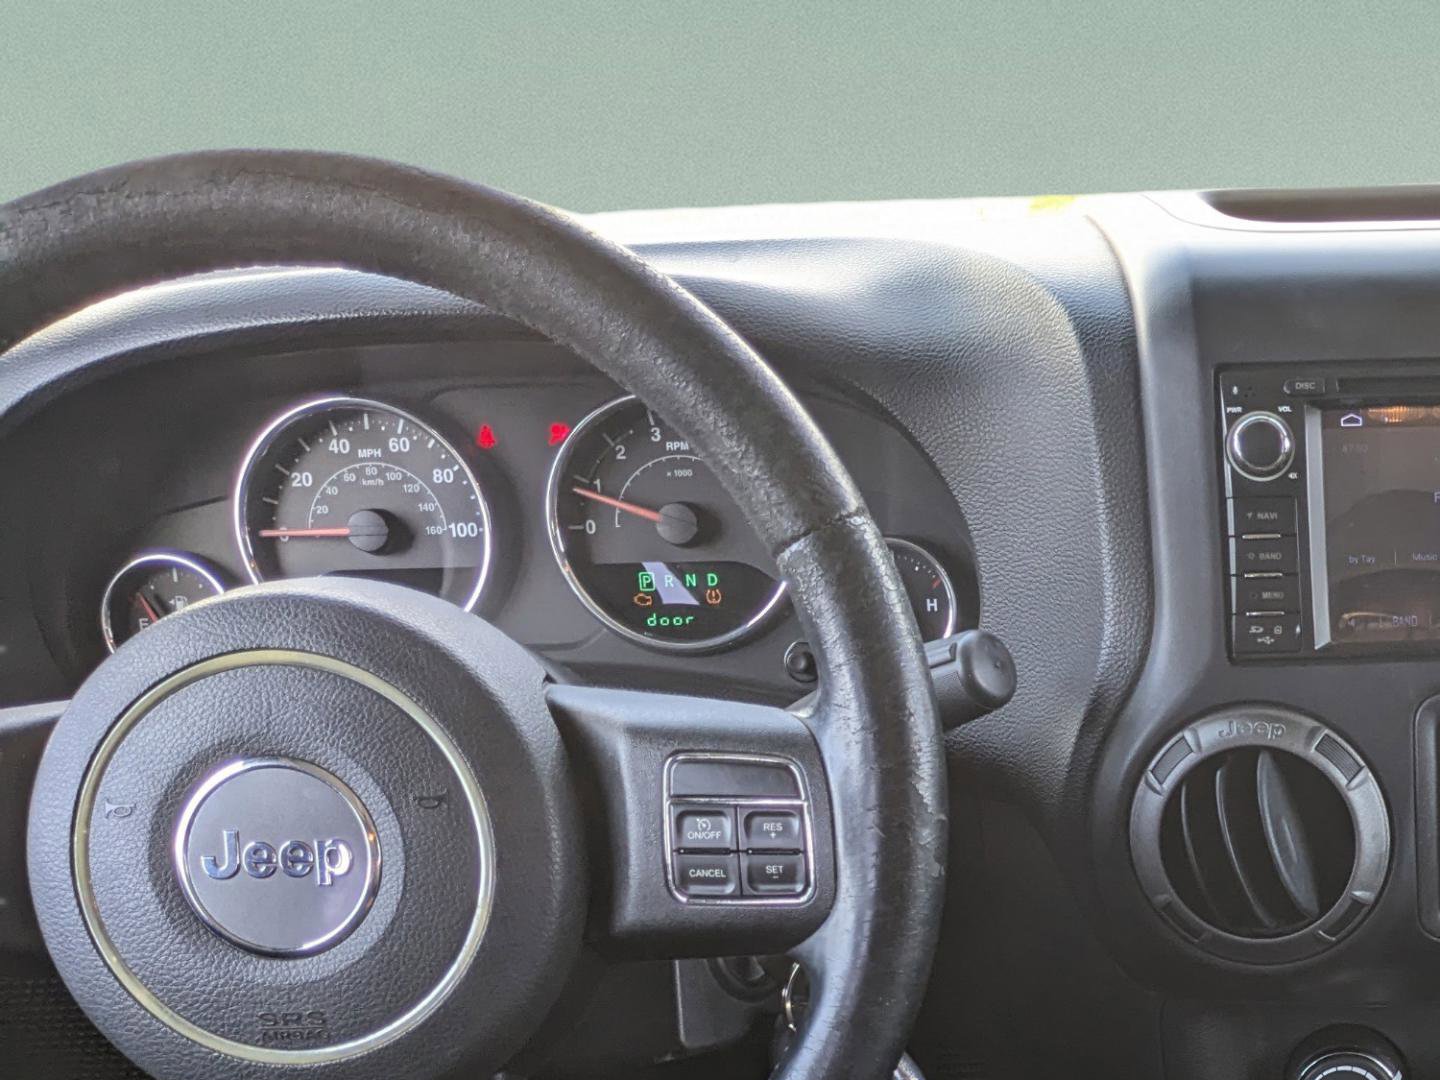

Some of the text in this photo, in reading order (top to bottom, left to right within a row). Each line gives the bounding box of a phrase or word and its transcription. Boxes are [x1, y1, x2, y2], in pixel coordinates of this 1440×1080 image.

[1295, 382, 1316, 390] DISC
[651, 427, 662, 441] 3
[329, 438, 349, 454] 40
[388, 437, 410, 452] 60
[665, 442, 689, 451] RPM
[358, 448, 382, 459] MPH
[615, 446, 627, 460] 2
[365, 467, 378, 476] 80
[385, 472, 403, 481] 100
[432, 468, 454, 483] 80
[673, 469, 693, 477] 1000
[291, 472, 312, 487] 20
[343, 473, 356, 483] 60
[361, 477, 384, 487] km/h
[325, 486, 338, 496] 40
[402, 484, 421, 494] 120
[593, 479, 601, 493] 1
[316, 505, 329, 514] 20
[418, 503, 435, 513] 140
[1257, 512, 1278, 520] NAVI
[425, 526, 442, 535] 160
[448, 522, 478, 538] 100
[586, 520, 596, 534] 0
[1412, 552, 1437, 561] Music
[664, 574, 675, 587] R
[685, 574, 697, 587] N
[707, 573, 718, 586] D
[926, 598, 938, 612] H
[647, 613, 694, 626] door
[1217, 720, 1286, 740] Jeep
[763, 822, 783, 831] RES
[687, 831, 721, 840] ON/OFF
[200, 826, 353, 887] Jeep
[689, 868, 726, 878] CANCEL
[765, 865, 783, 874] SET
